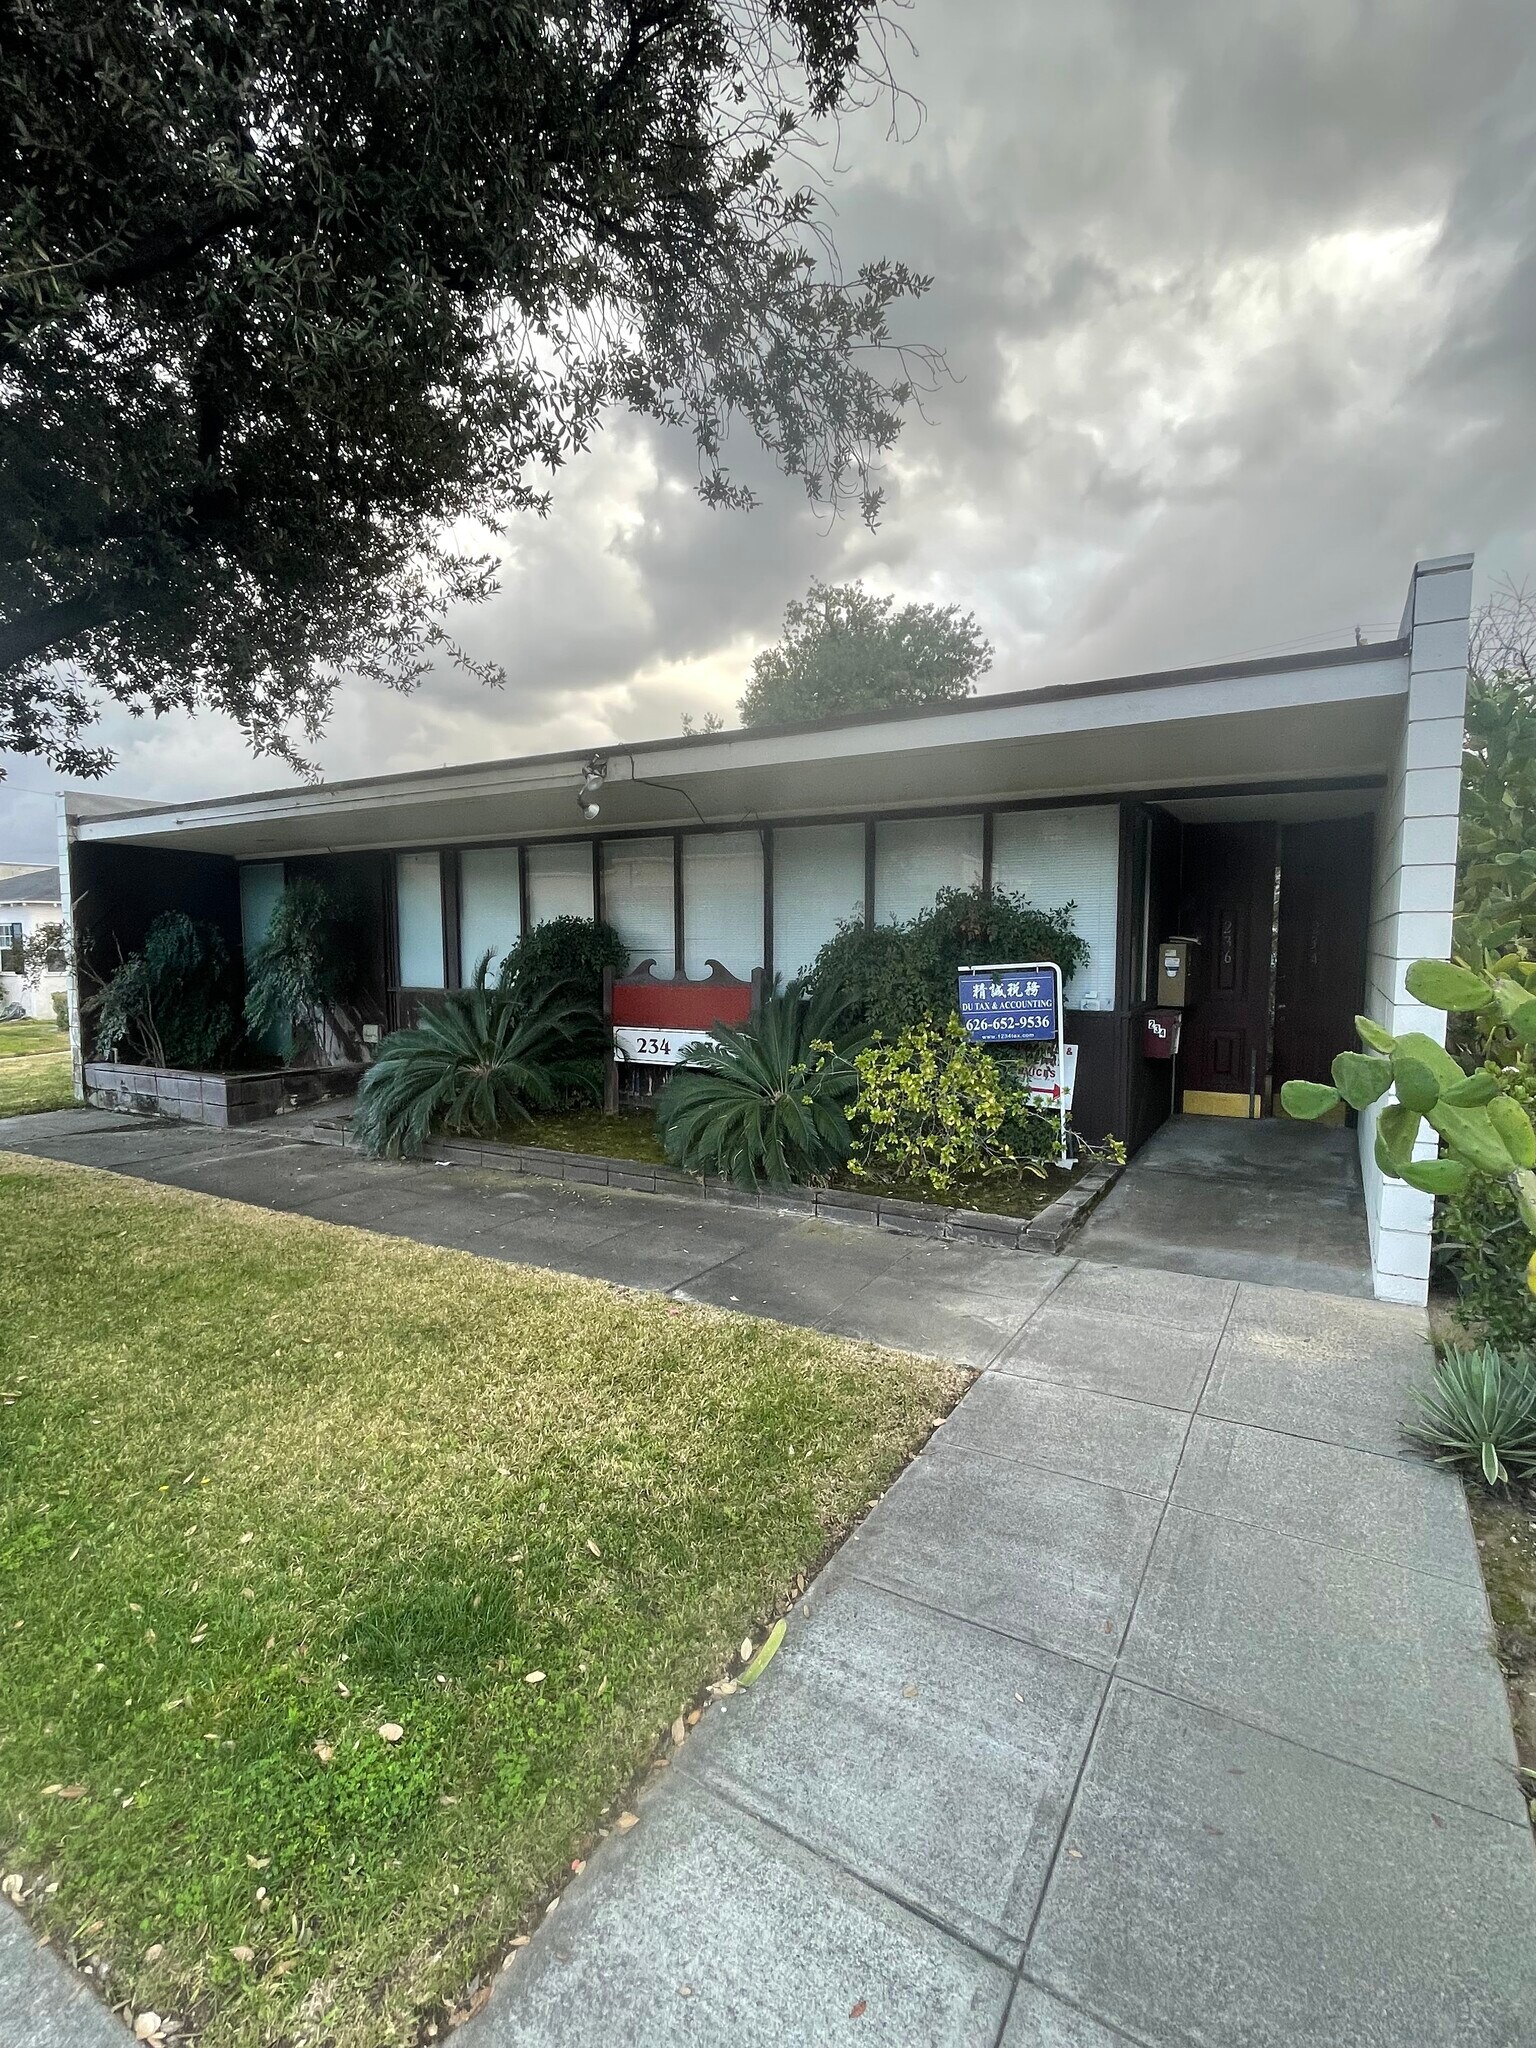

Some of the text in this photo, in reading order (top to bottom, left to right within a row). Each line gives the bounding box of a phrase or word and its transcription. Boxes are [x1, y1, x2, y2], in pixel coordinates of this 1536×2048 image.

[962, 999, 1053, 1011] DU TAX & ACCOUNTING
[966, 1015, 1050, 1031] 626-652-9536
[1149, 1020, 1166, 1037] 234
[636, 1037, 671, 1054] 234
[1066, 1047, 1073, 1055] &
